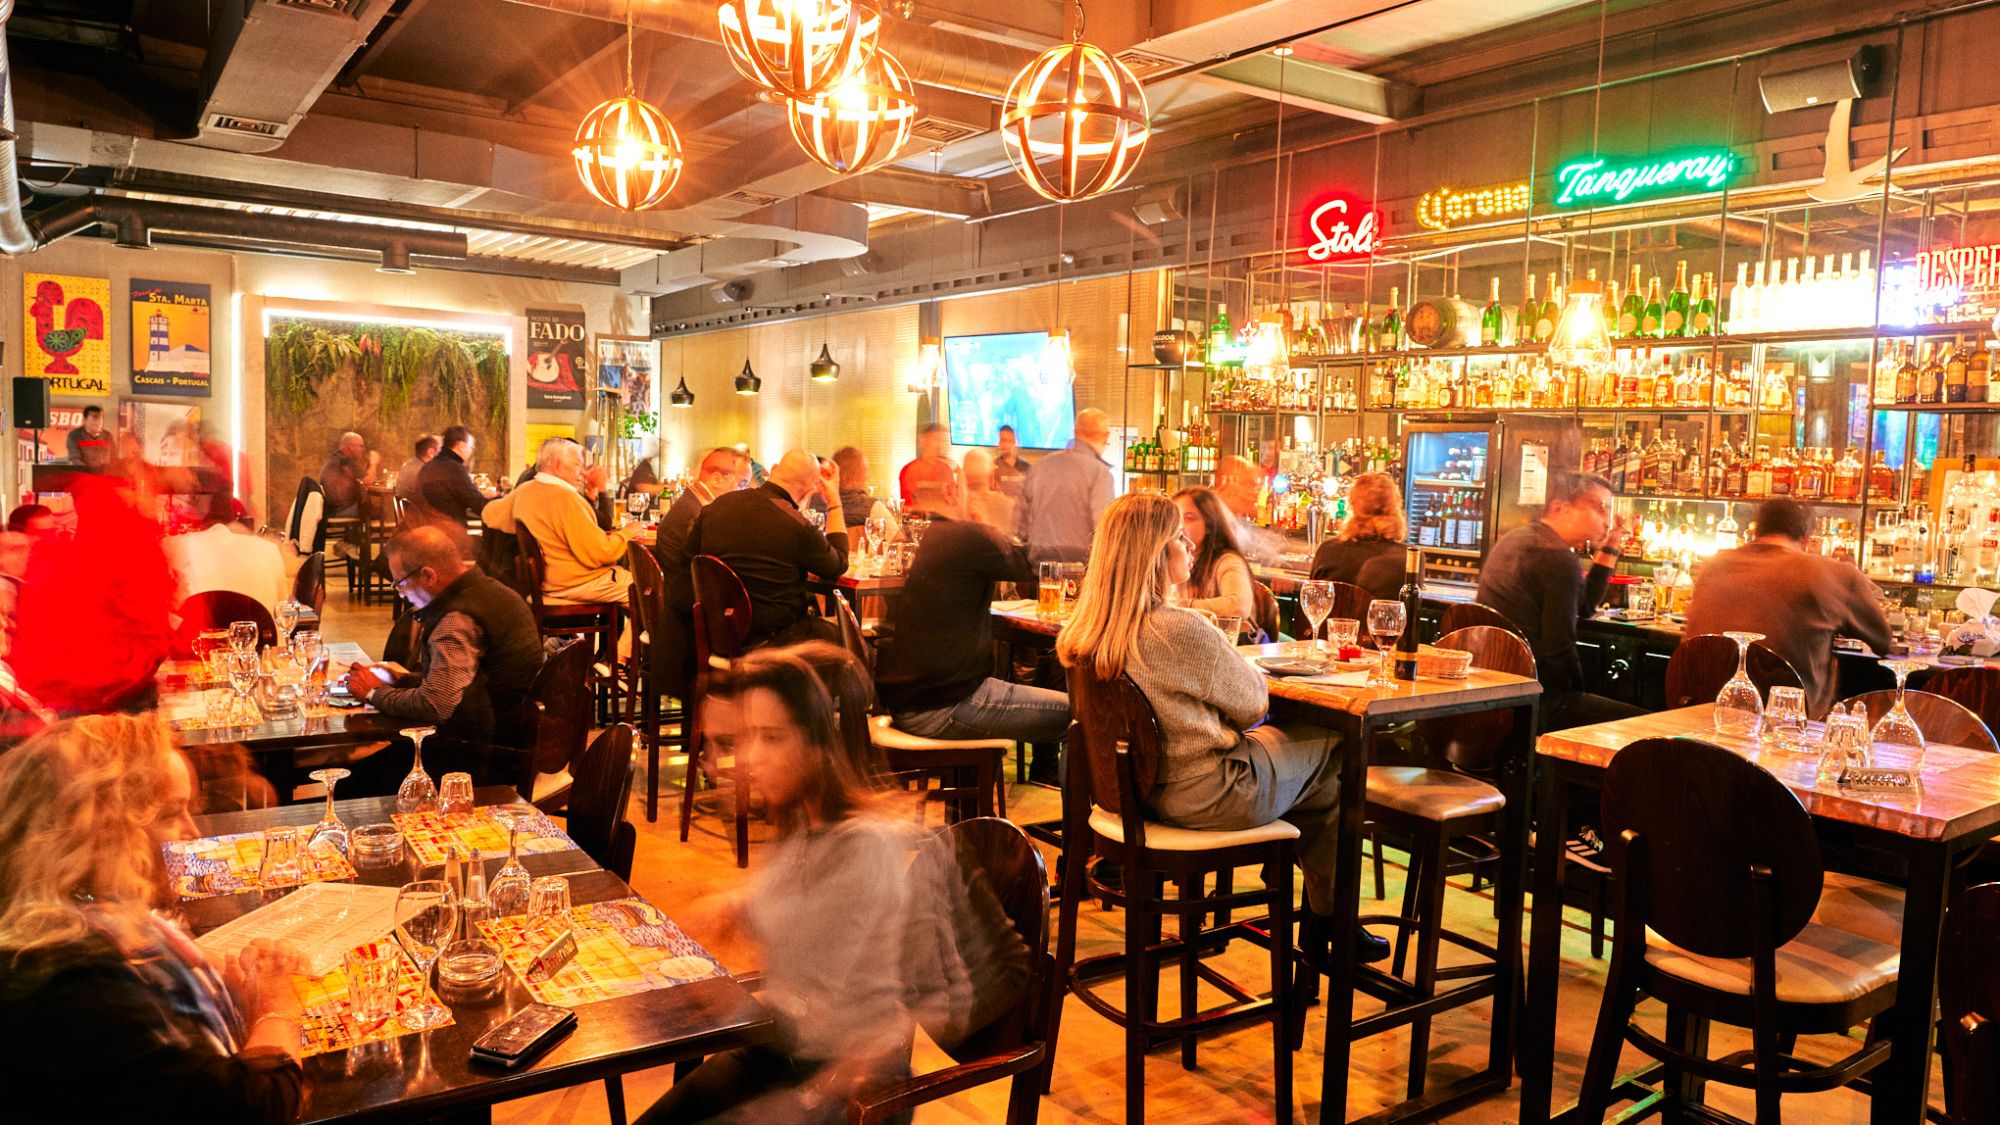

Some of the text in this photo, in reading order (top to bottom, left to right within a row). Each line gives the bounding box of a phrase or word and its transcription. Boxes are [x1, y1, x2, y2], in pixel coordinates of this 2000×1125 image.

[1557, 153, 1727, 203] Tanqueray
[1416, 186, 1529, 231] Corona
[530, 321, 585, 341] FADO
[50, 411, 83, 426] SBO
